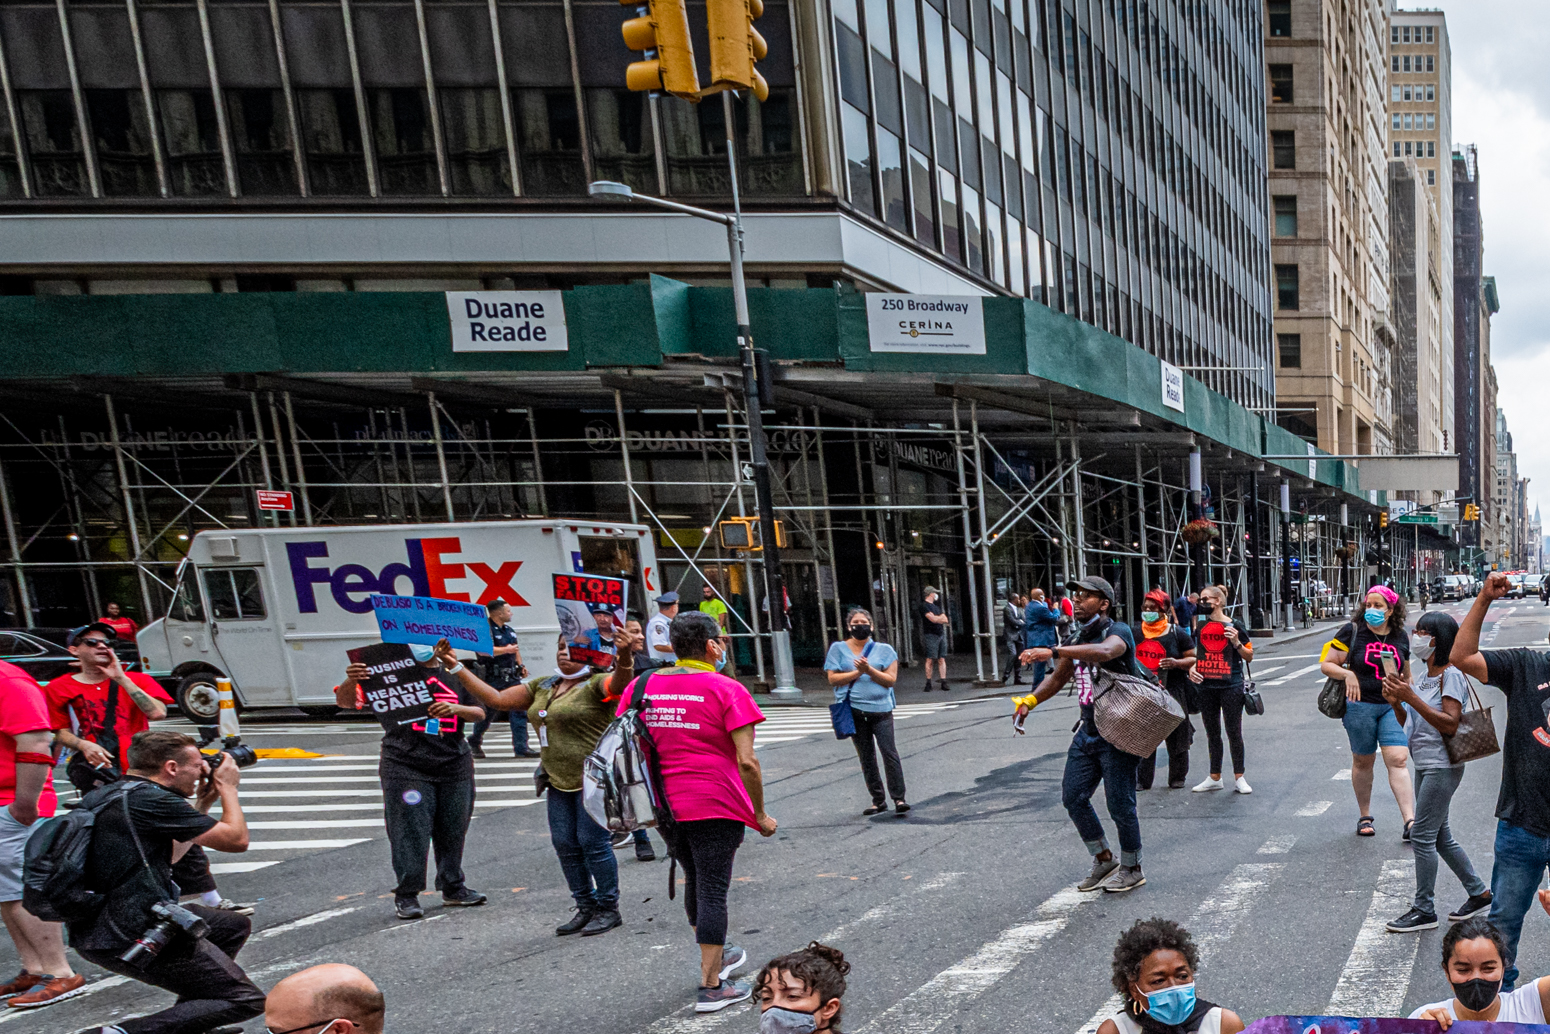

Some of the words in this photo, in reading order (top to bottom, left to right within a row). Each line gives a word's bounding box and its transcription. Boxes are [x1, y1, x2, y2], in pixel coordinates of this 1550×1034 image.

[464, 298, 545, 319] Duane
[881, 298, 904, 311] 250
[907, 299, 969, 315] Broadway
[470, 320, 547, 342] Reade
[898, 319, 954, 330] CERINA
[717, 421, 810, 451] rede
[285, 537, 532, 614] FedEx
[555, 575, 622, 595] STOP
[555, 589, 622, 605] FAILING
[425, 600, 435, 611] A
[437, 601, 462, 614] BROKEN
[382, 619, 398, 631] ON
[403, 621, 479, 643] HOMELESSNESS
[1202, 633, 1228, 641] STOP
[1137, 650, 1165, 660] STOP
[1204, 652, 1224, 660] THE
[366, 658, 416, 675] OUSING
[1197, 660, 1231, 669] HOTEL
[383, 674, 399, 685] IS
[366, 680, 427, 702] HEALTH
[678, 694, 705, 703] WORKS
[372, 689, 433, 713] CARE
[645, 721, 700, 730] HOMELESSNESS
